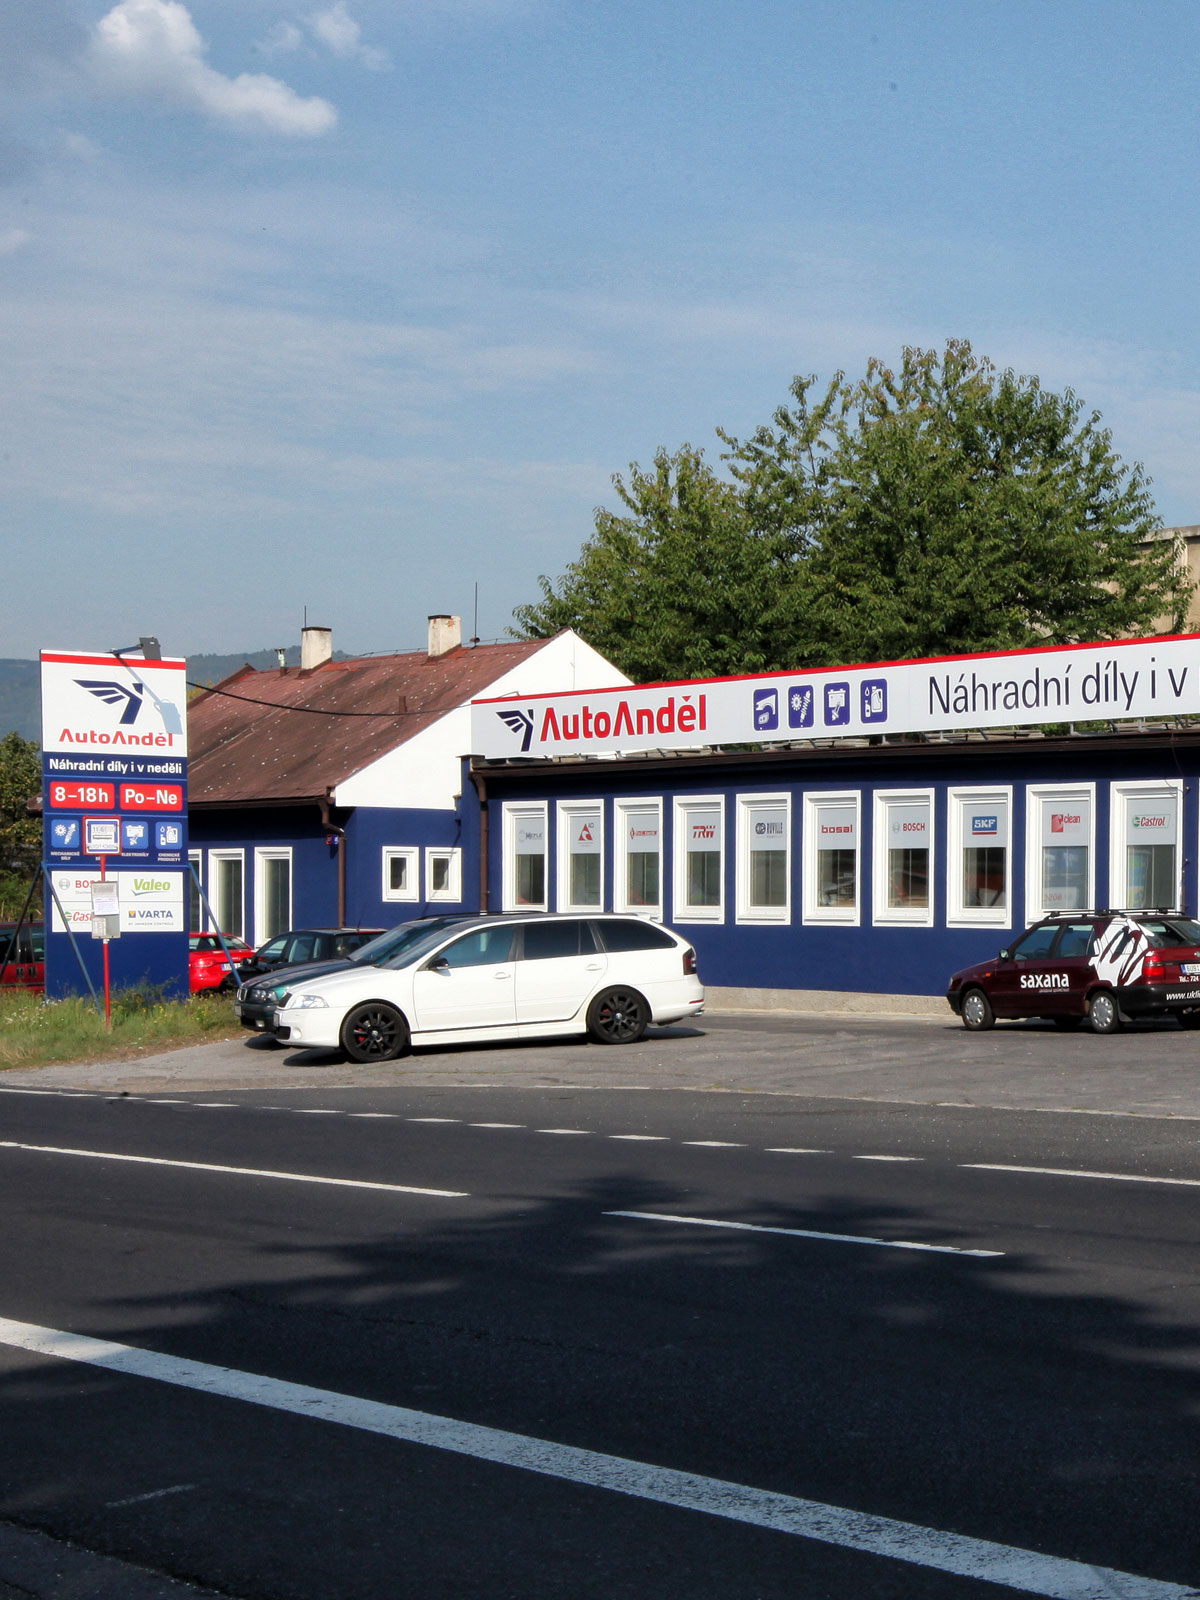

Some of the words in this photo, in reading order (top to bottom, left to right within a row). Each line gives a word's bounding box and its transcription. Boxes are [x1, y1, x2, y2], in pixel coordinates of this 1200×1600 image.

[928, 663, 1072, 715] Náhradní
[1081, 660, 1139, 711] díly
[1150, 656, 1157, 700] i
[1167, 666, 1188, 698] v
[539, 693, 708, 742] AutoAnděl
[59, 728, 173, 747] AutoAnděl
[49, 758, 104, 771] Náhradní
[106, 760, 128, 774] díly
[130, 761, 135, 772] i
[137, 764, 145, 773] v
[147, 762, 182, 774] neděli
[902, 822, 926, 832] BOSCH
[974, 819, 996, 829] SKF
[1140, 815, 1165, 827] Castrol
[692, 825, 716, 839] TRW
[821, 824, 853, 833] bosal
[133, 878, 171, 891] Valeo
[138, 910, 174, 919] VARTA
[1020, 973, 1070, 989] saxana
